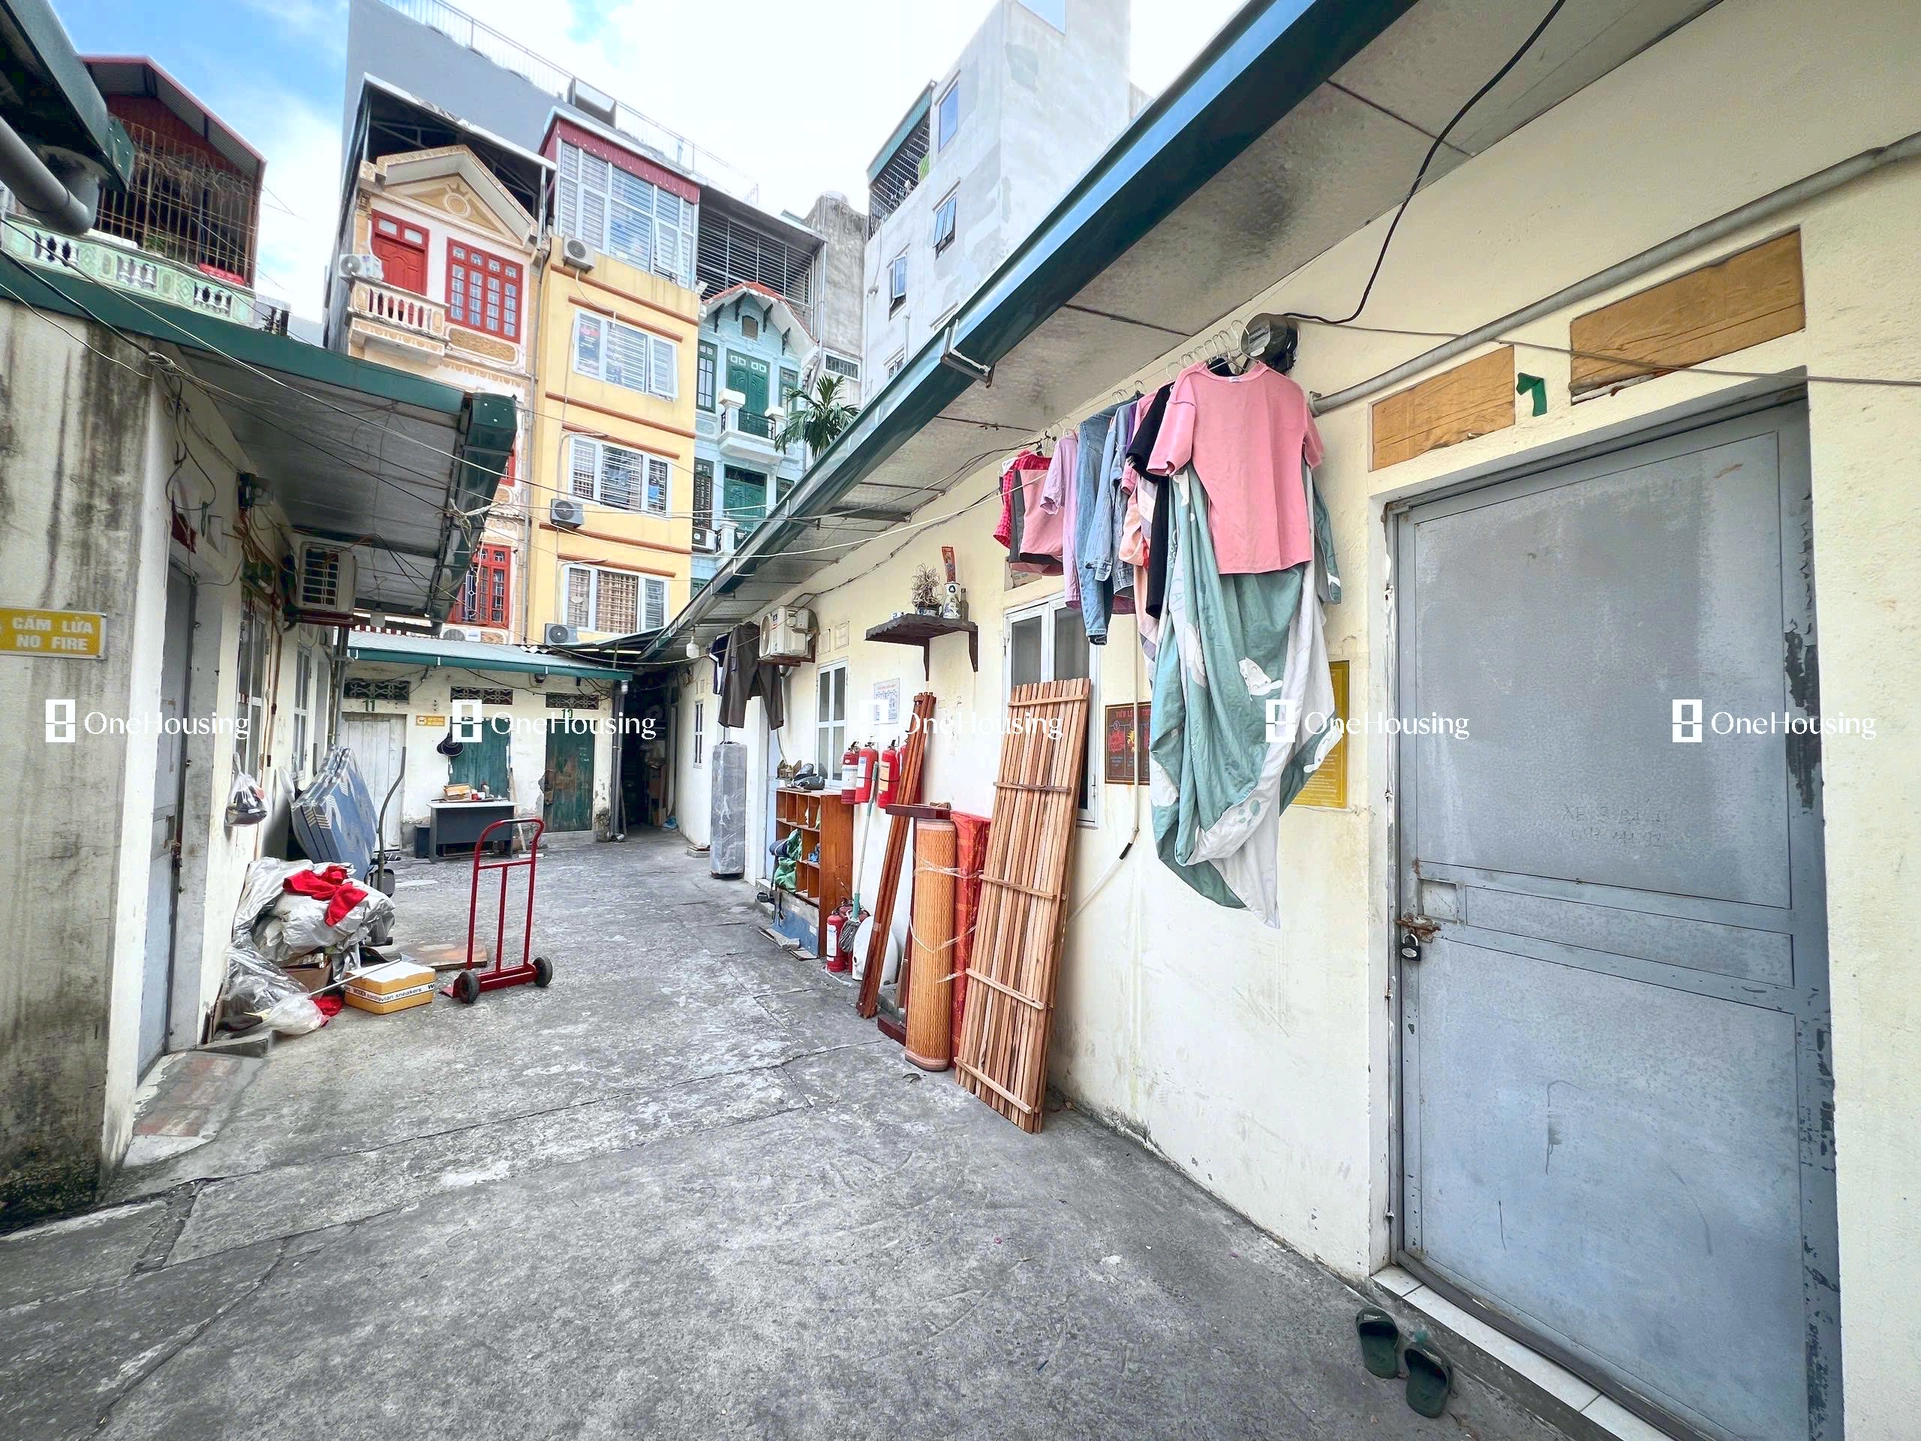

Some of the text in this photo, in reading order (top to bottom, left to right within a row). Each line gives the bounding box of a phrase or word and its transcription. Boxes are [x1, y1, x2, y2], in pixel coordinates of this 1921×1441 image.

[16, 634, 88, 651] NO FIRE
[362, 699, 376, 712] 11
[395, 988, 422, 999] sneakers
